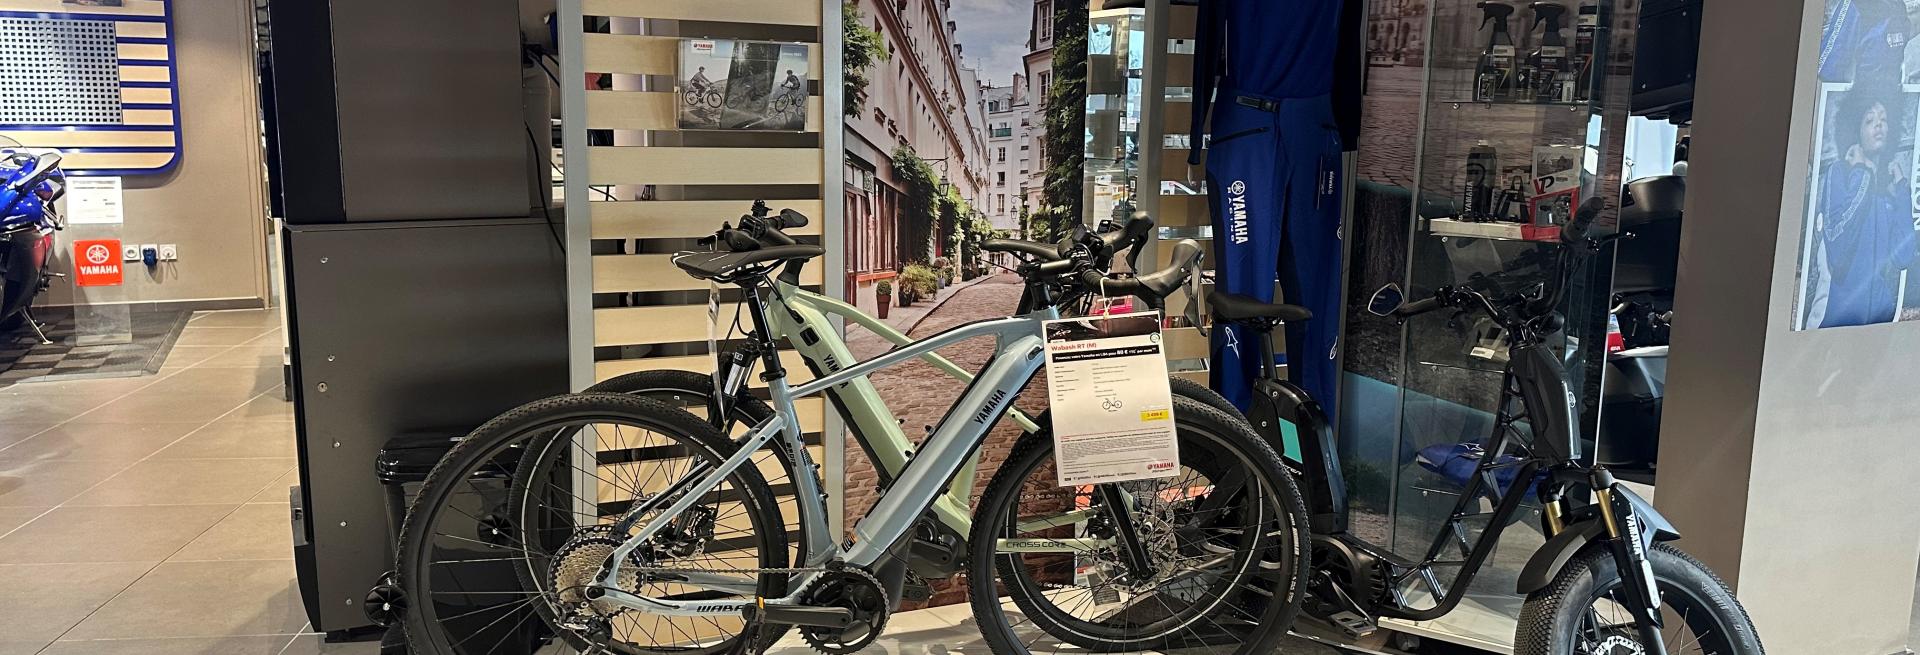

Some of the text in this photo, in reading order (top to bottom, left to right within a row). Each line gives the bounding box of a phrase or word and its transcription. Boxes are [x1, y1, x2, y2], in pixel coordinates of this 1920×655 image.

[1464, 181, 1473, 212] YAMAHA
[1232, 195, 1248, 244] YAMAHA
[80, 265, 119, 275] YAMAHA
[824, 354, 848, 388] YAMA
[974, 390, 1006, 424] YAMAHA
[1626, 514, 1640, 555] YAMAHA
